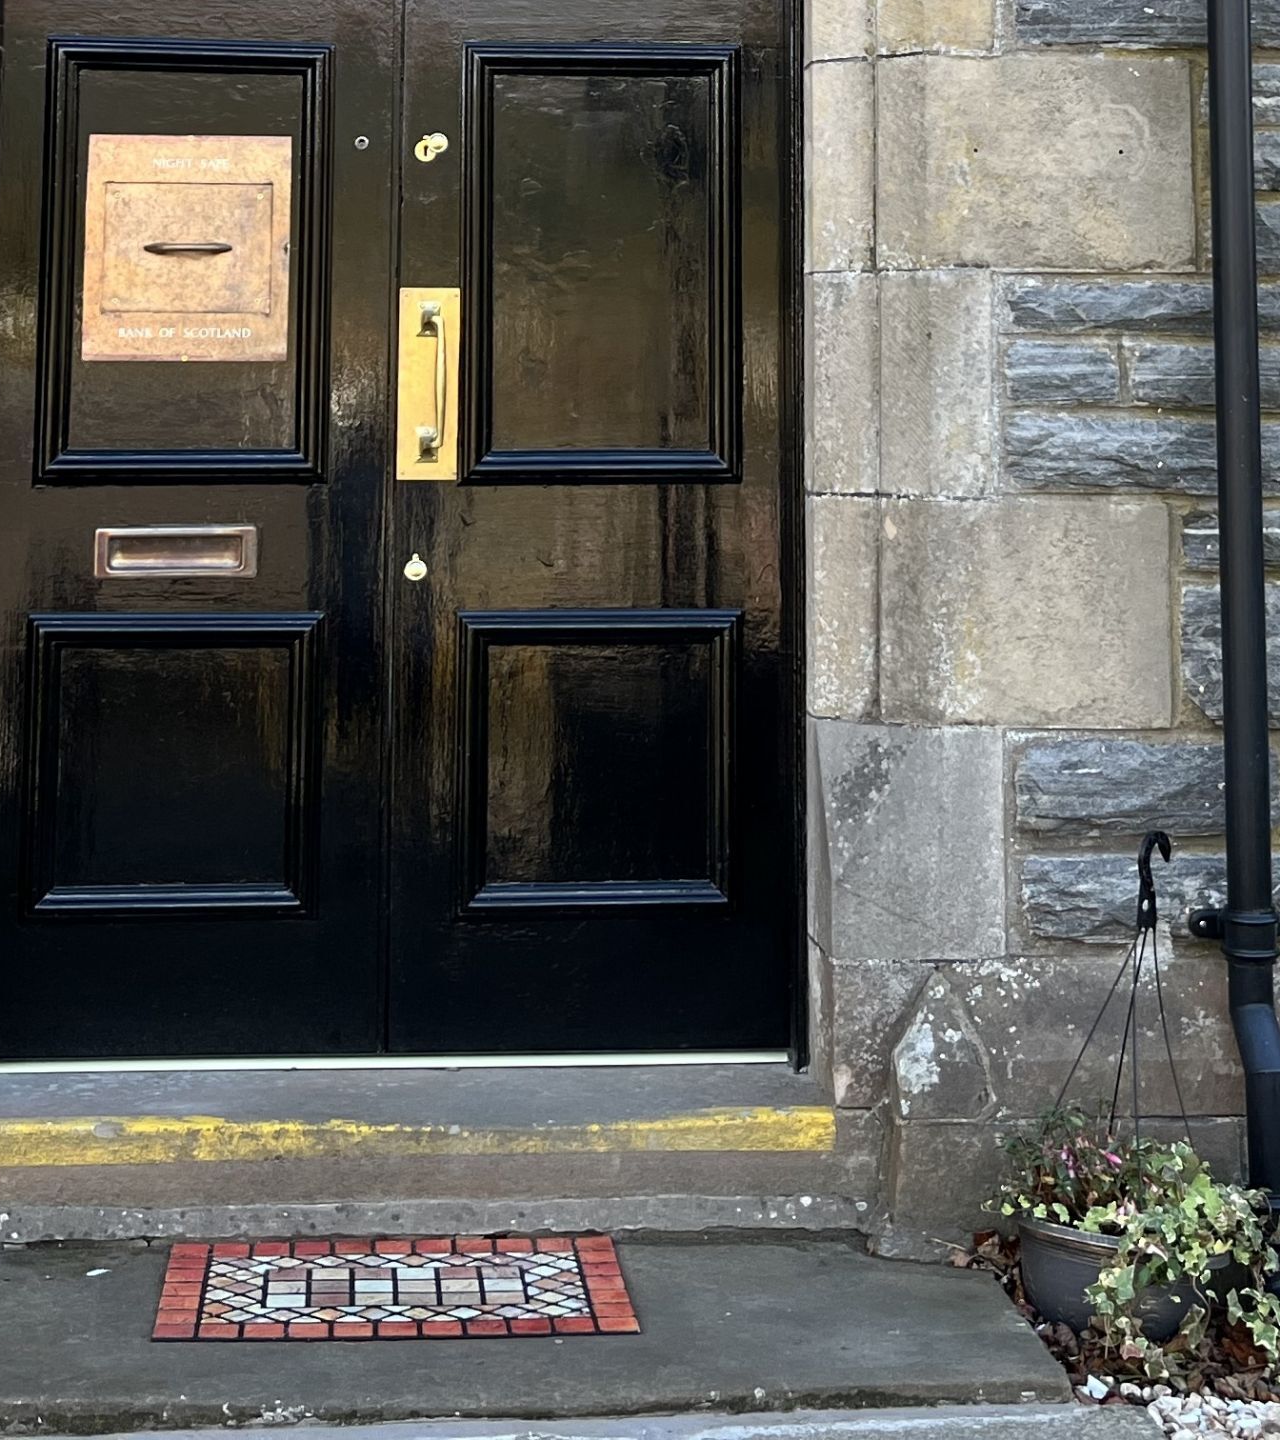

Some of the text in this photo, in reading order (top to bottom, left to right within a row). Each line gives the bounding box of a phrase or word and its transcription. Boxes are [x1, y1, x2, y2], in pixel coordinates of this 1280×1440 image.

[152, 158, 230, 170] NIGHT SAFE
[118, 327, 252, 339] BANK OF SCOTLAND
